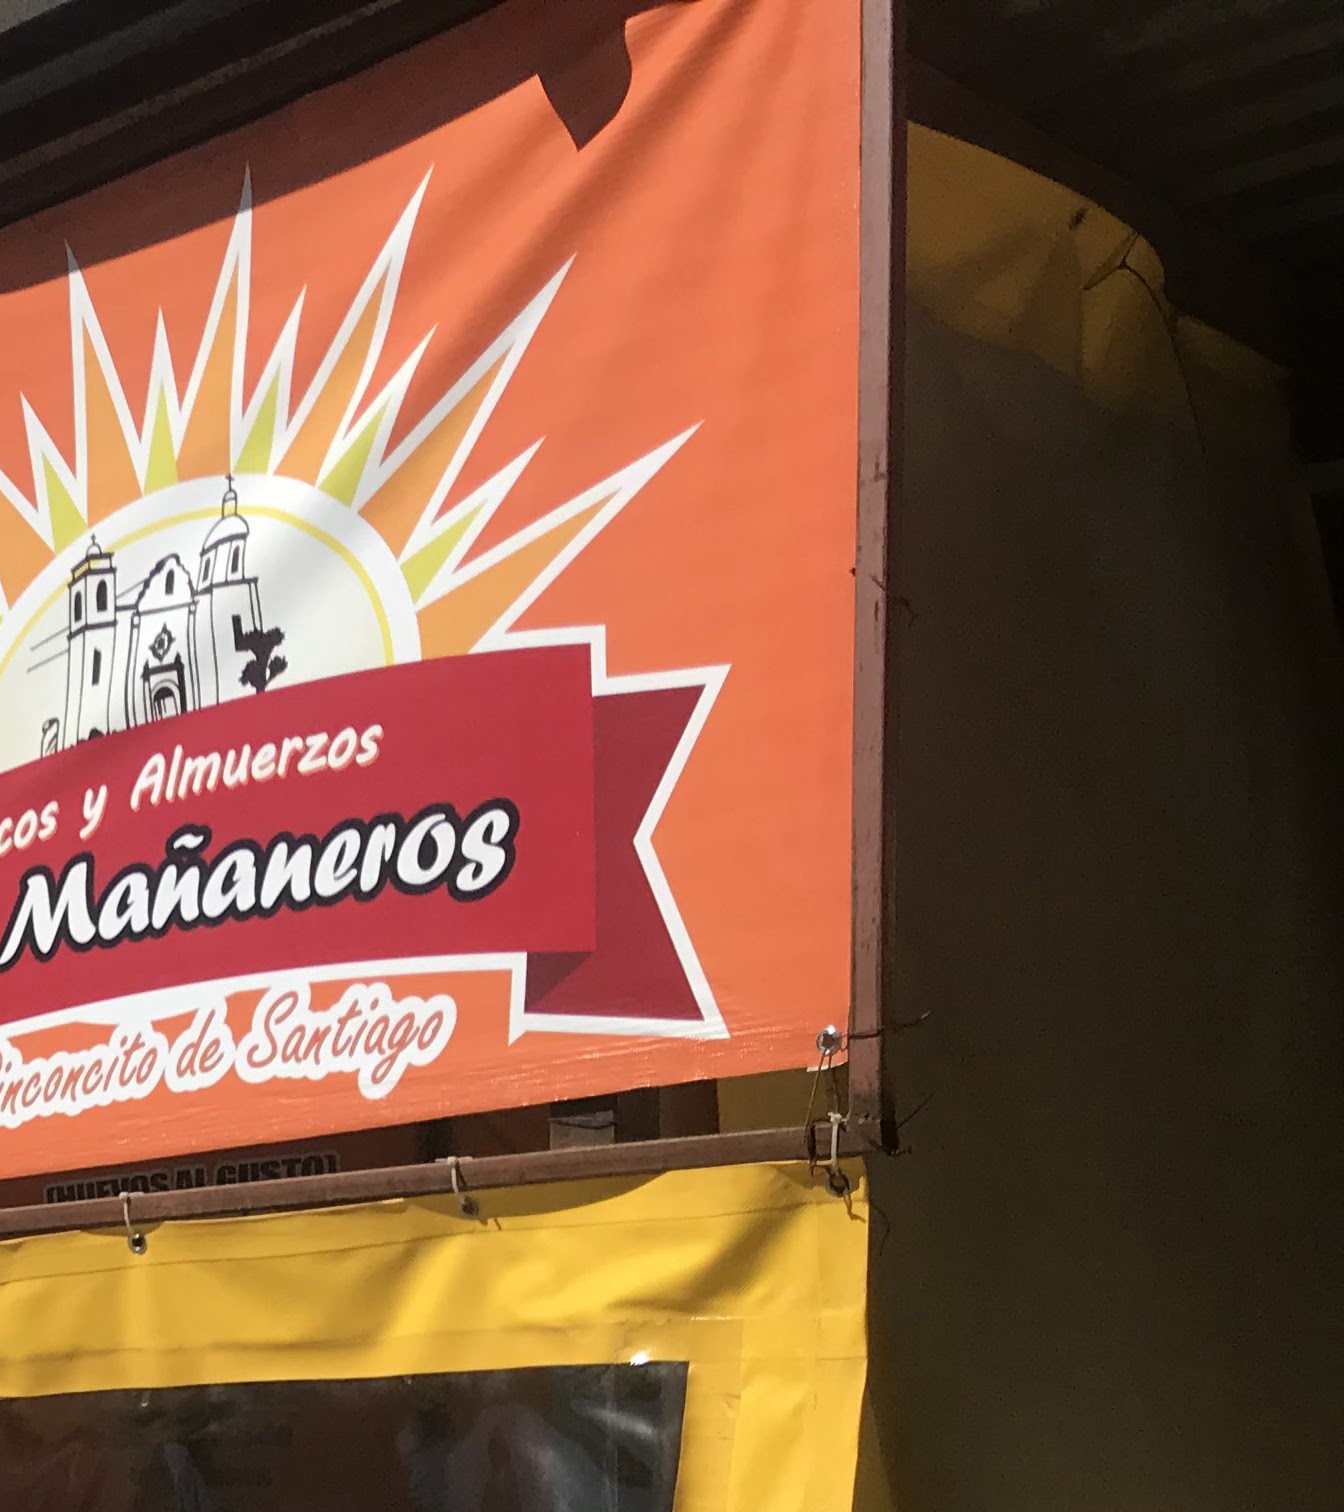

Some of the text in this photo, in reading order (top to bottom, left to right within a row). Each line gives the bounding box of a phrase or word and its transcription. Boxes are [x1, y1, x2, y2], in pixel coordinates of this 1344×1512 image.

[79, 783, 108, 839] y
[130, 724, 384, 813] Almuerzos
[176, 1008, 224, 1075] de
[246, 990, 446, 1084] Santiago
